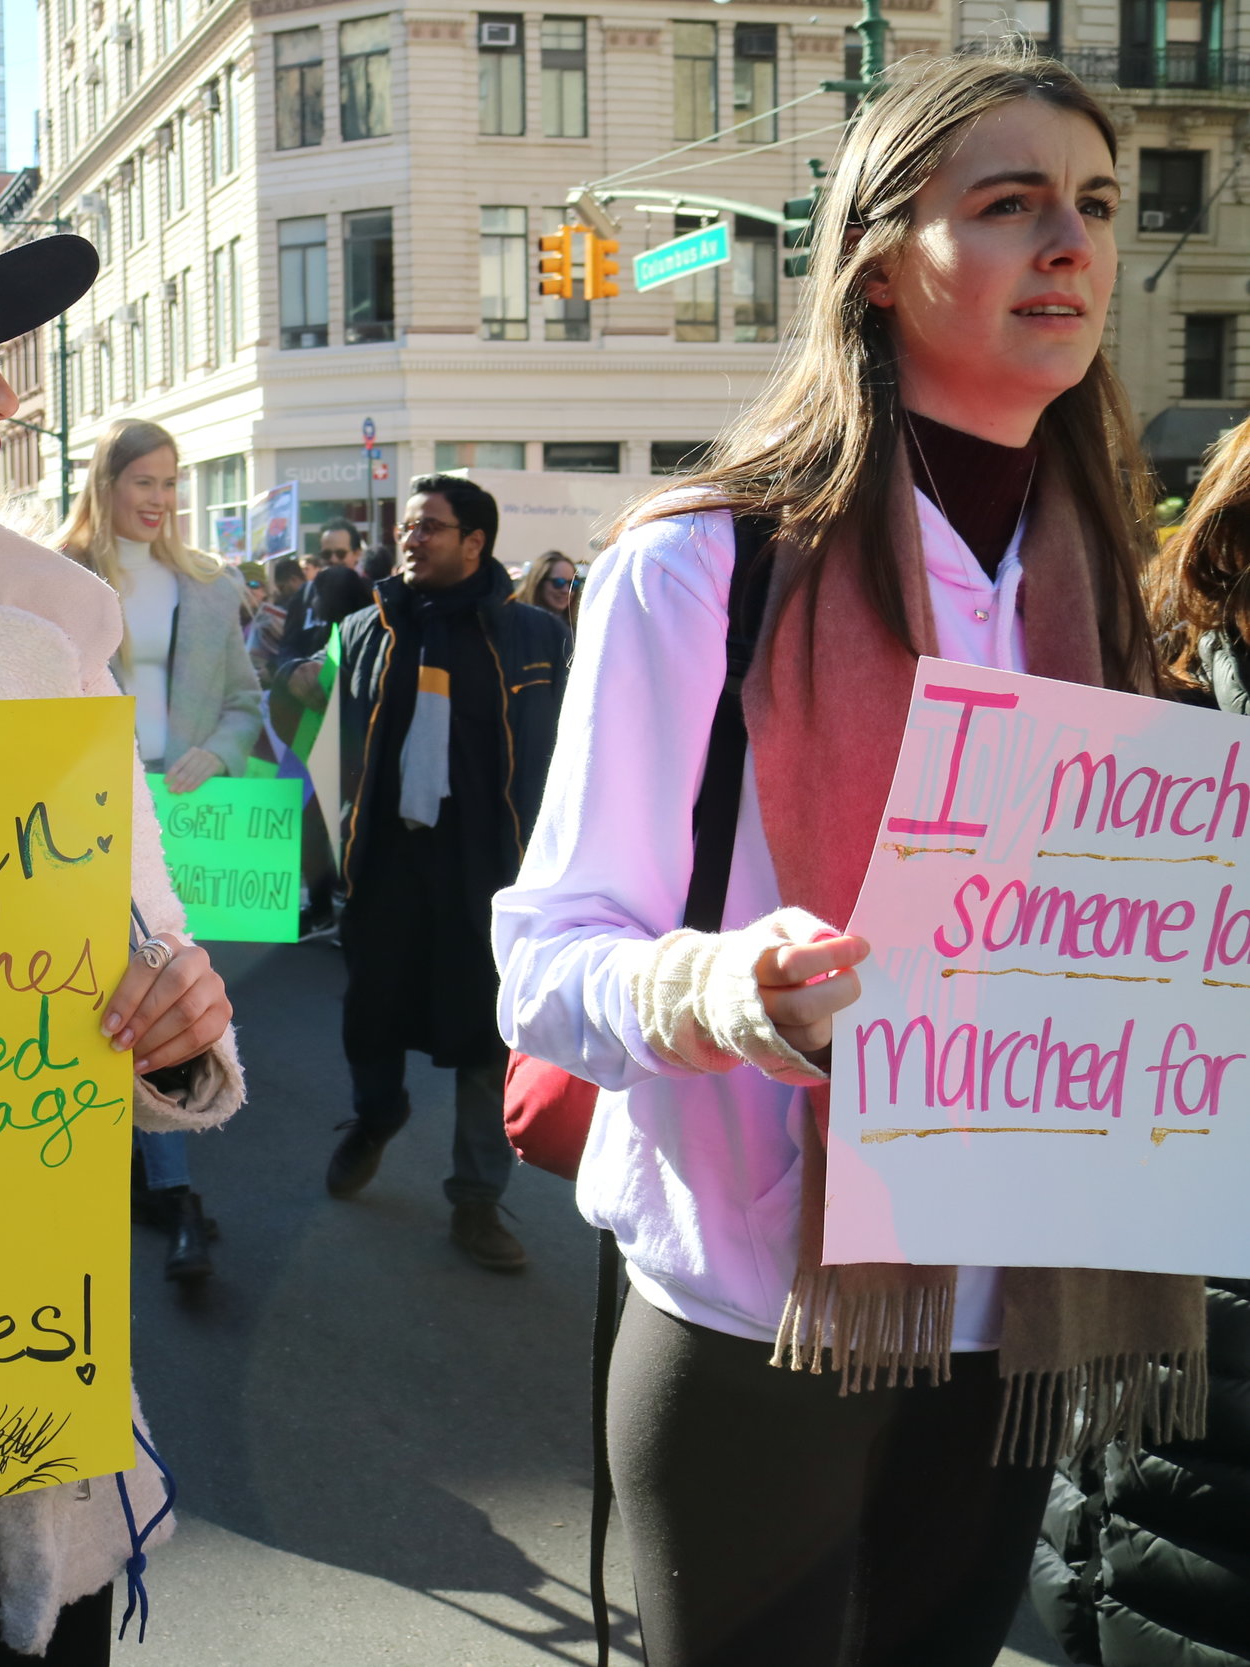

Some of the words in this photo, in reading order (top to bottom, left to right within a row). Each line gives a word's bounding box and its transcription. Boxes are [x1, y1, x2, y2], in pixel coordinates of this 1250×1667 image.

[887, 684, 1020, 838] I
[1042, 741, 1250, 843] march
[167, 802, 233, 841] GET
[247, 806, 294, 840] IN
[166, 863, 292, 911] MATION
[934, 873, 1196, 963] someone
[1201, 883, 1250, 973] lo
[1144, 1022, 1248, 1117] for
